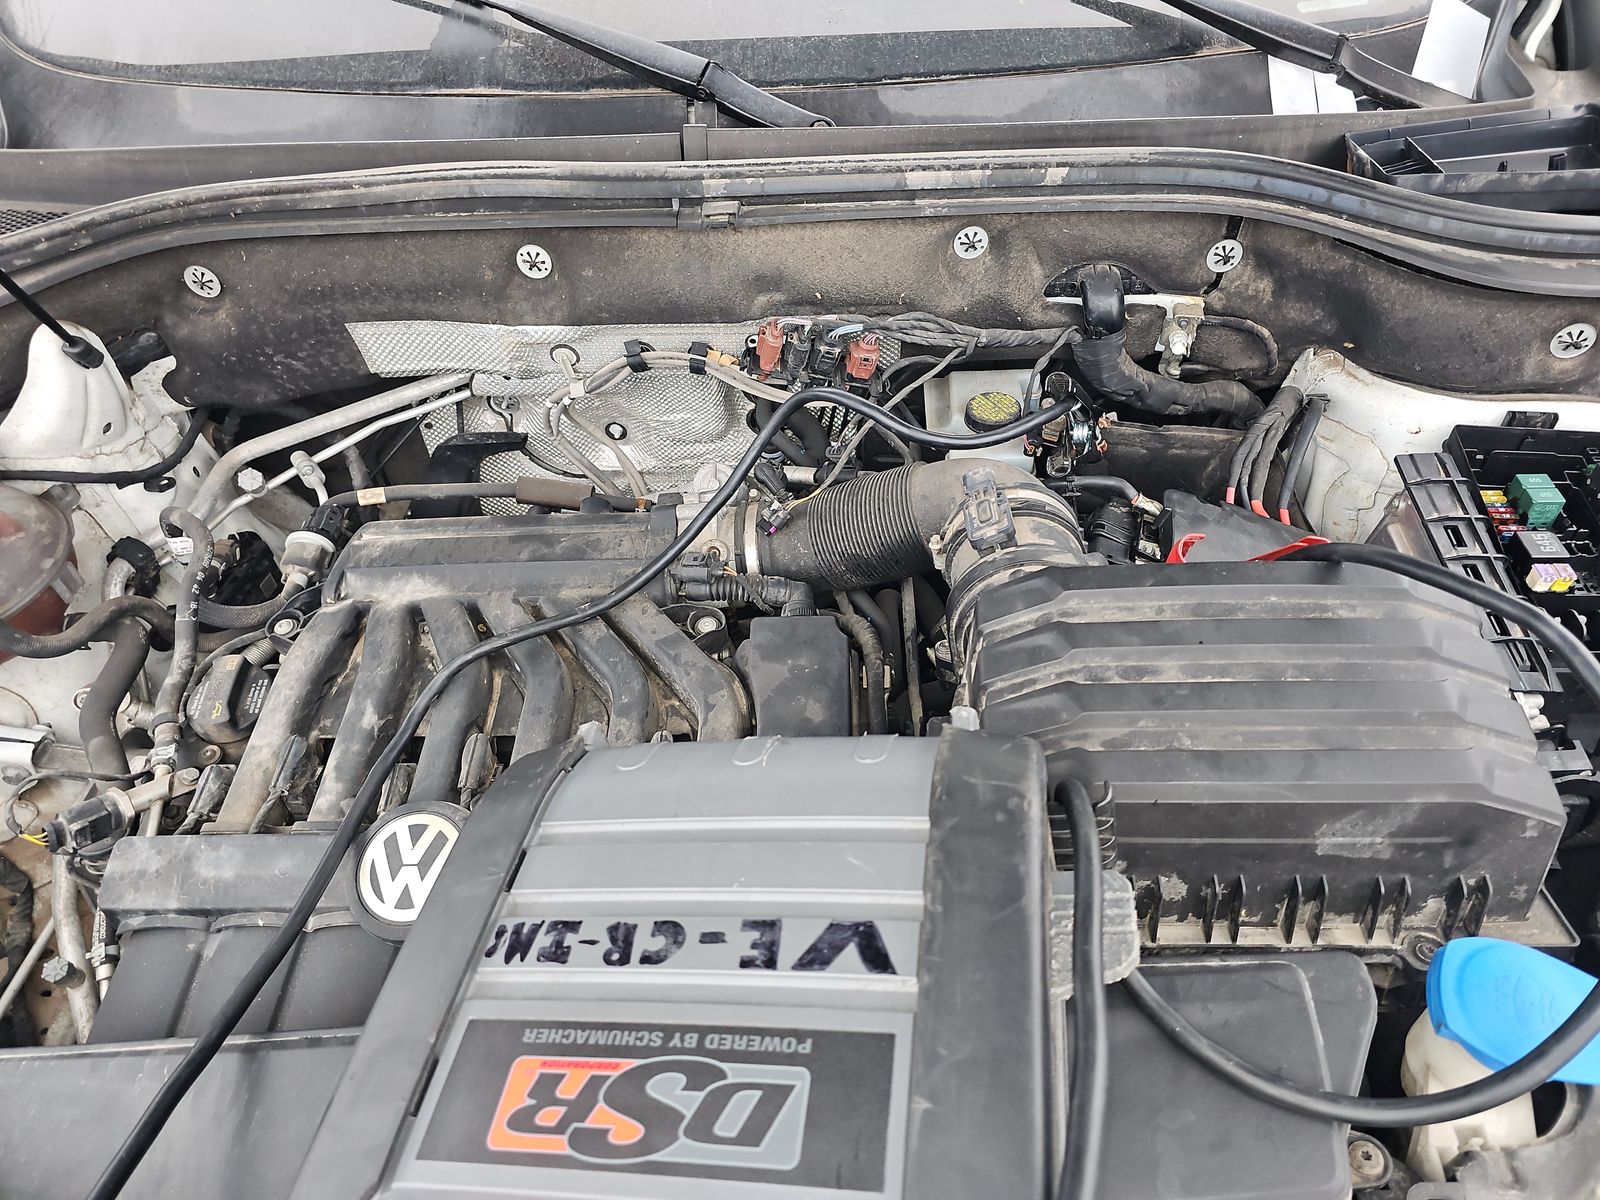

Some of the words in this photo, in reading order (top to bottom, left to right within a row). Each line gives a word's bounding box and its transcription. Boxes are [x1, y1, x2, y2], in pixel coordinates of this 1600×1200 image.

[522, 1028, 665, 1048] SCHUMACHER
[669, 1031, 698, 1049] BY
[705, 1032, 813, 1054] POWERED
[505, 1056, 799, 1162] DSR
